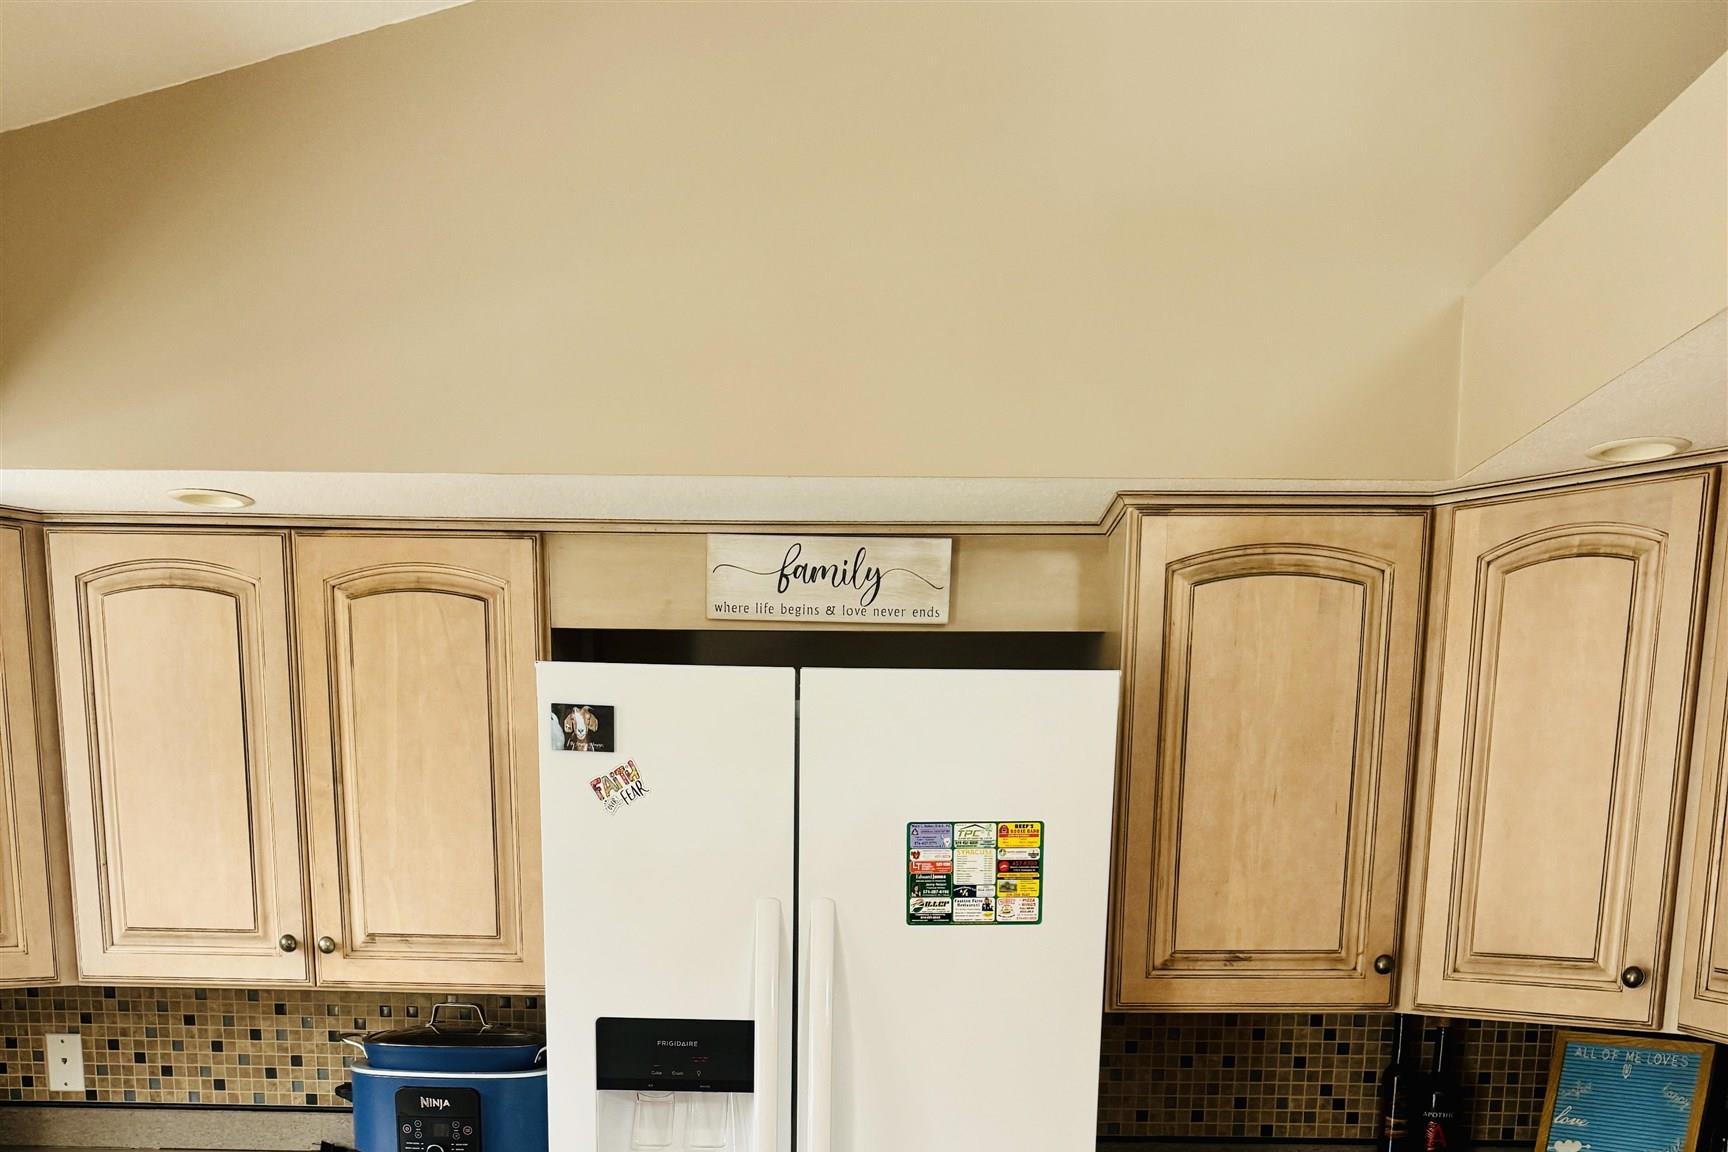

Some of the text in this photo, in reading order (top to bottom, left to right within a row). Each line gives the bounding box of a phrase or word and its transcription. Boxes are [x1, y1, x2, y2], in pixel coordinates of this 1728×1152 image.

[714, 602, 940, 618] where life begins & love never ends
[620, 780, 649, 806] FEAR
[1574, 1047, 1689, 1068] ALL OF ME LOVES
[420, 1096, 450, 1110] NINJA
